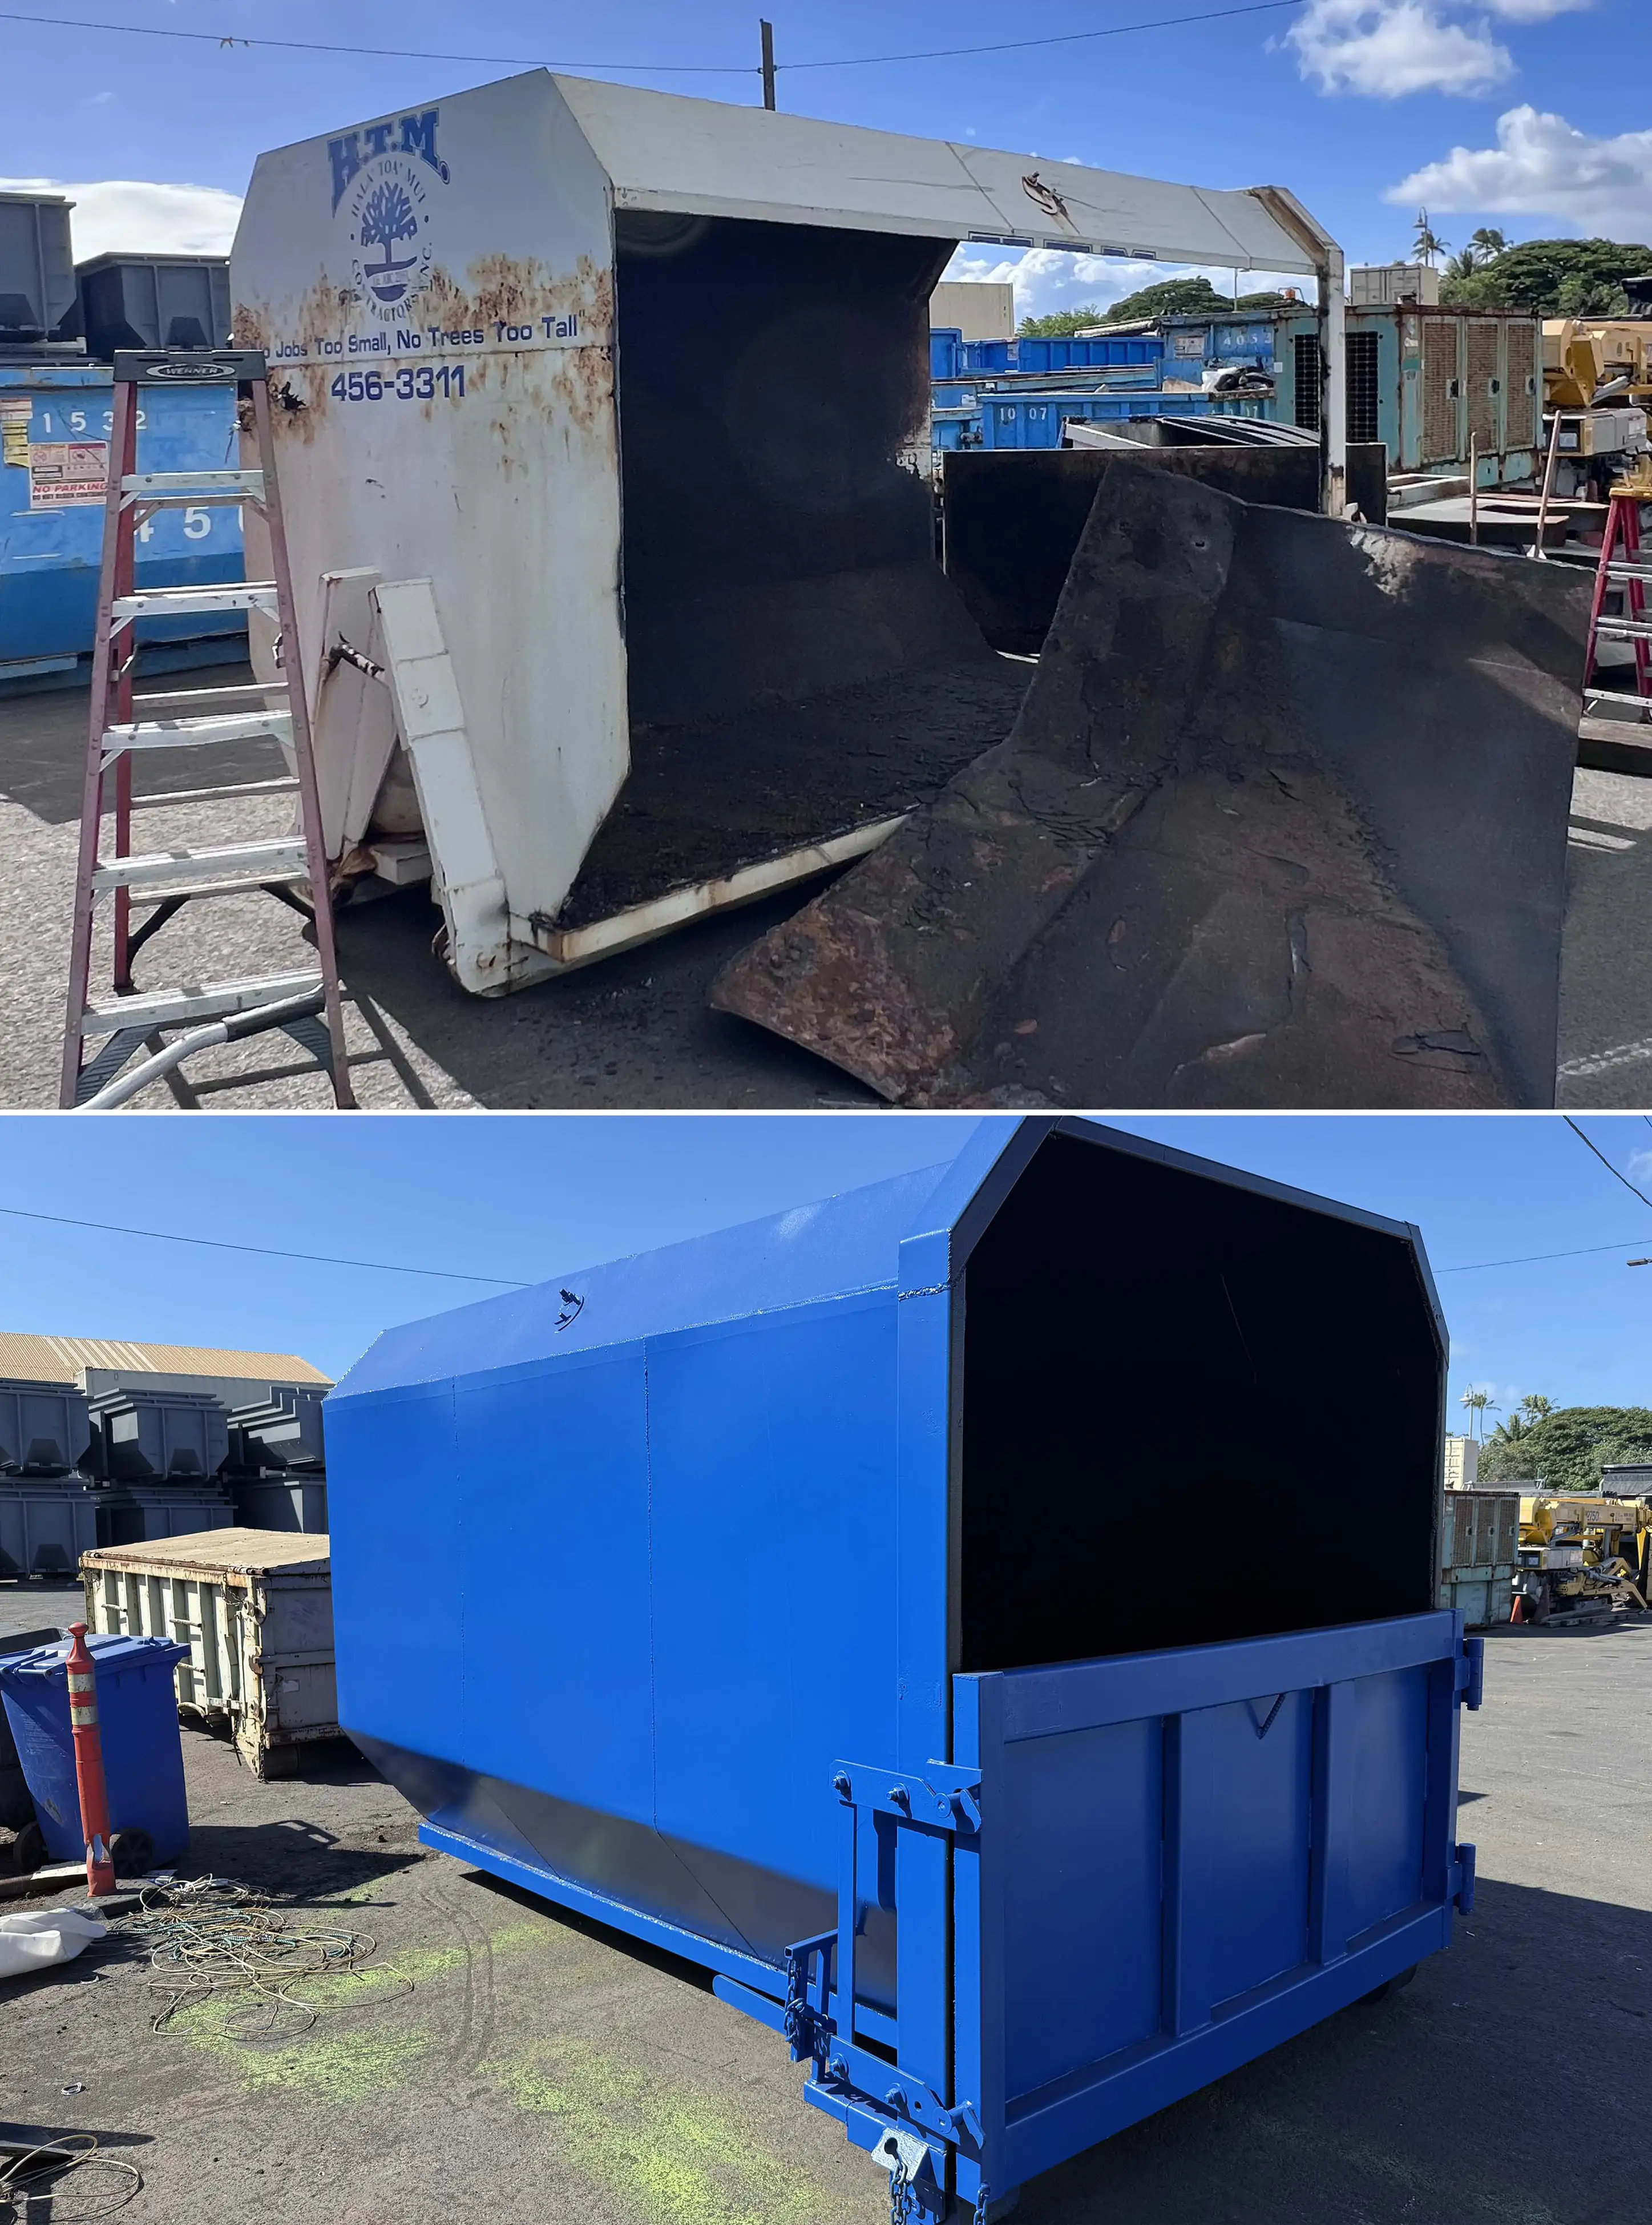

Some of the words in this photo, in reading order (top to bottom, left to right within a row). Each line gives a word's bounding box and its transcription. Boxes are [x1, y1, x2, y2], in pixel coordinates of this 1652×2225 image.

[276, 341, 307, 358] Jobs
[314, 338, 342, 355] Too
[349, 330, 390, 355] Small,
[397, 329, 421, 349] No
[429, 327, 484, 346] Trees
[493, 321, 532, 342] Too
[331, 365, 465, 401] 456-3311
